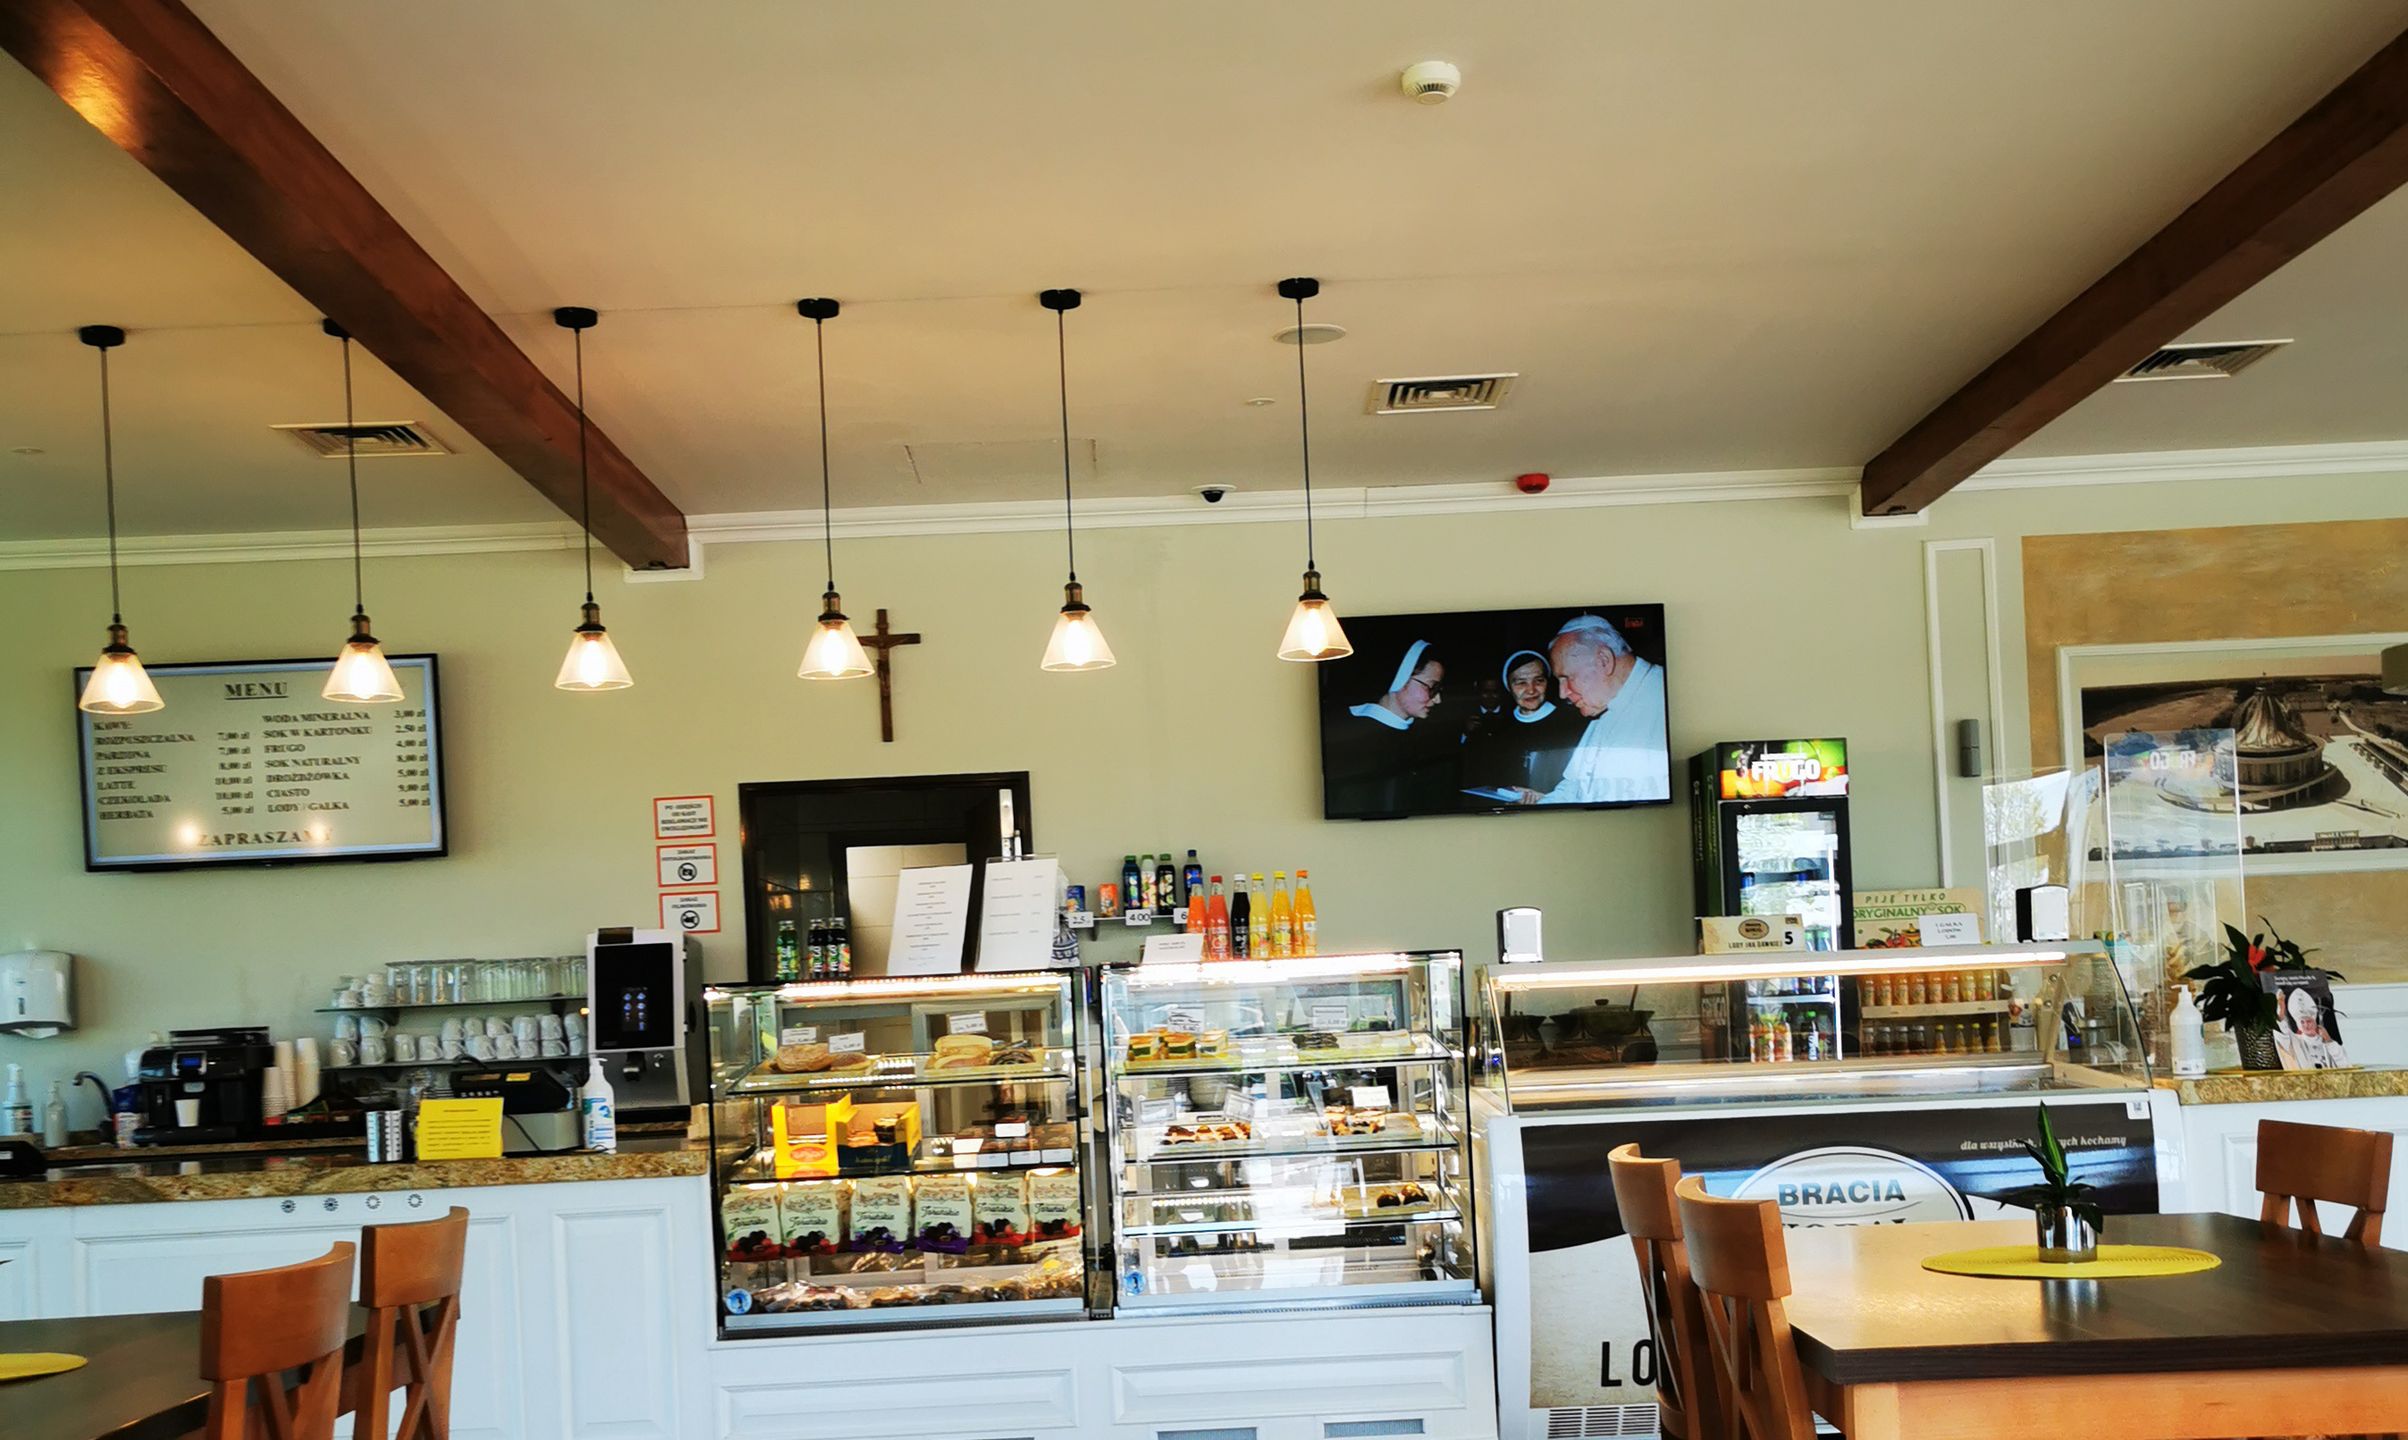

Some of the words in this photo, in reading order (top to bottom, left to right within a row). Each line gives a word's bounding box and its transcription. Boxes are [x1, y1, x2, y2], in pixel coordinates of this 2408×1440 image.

[224, 682, 287, 697] MENU
[262, 714, 299, 723] WODA
[301, 711, 371, 721] MINERALNA
[263, 729, 288, 738] SOK
[264, 743, 306, 753] FRUGO
[264, 759, 290, 768] SOK
[291, 756, 361, 767] NATURALNY
[1751, 759, 1820, 783] FRUGO
[266, 788, 310, 798] CIASTO
[1904, 892, 1946, 903] TYLKO
[1853, 906, 1927, 919] ORYGINALNY
[1938, 905, 1961, 914] SOK
[1785, 931, 1793, 945] 5
[1960, 1140, 1978, 1150] dla
[2080, 1136, 2128, 1148] kochamy
[1778, 1179, 1906, 1206] BRACIA
